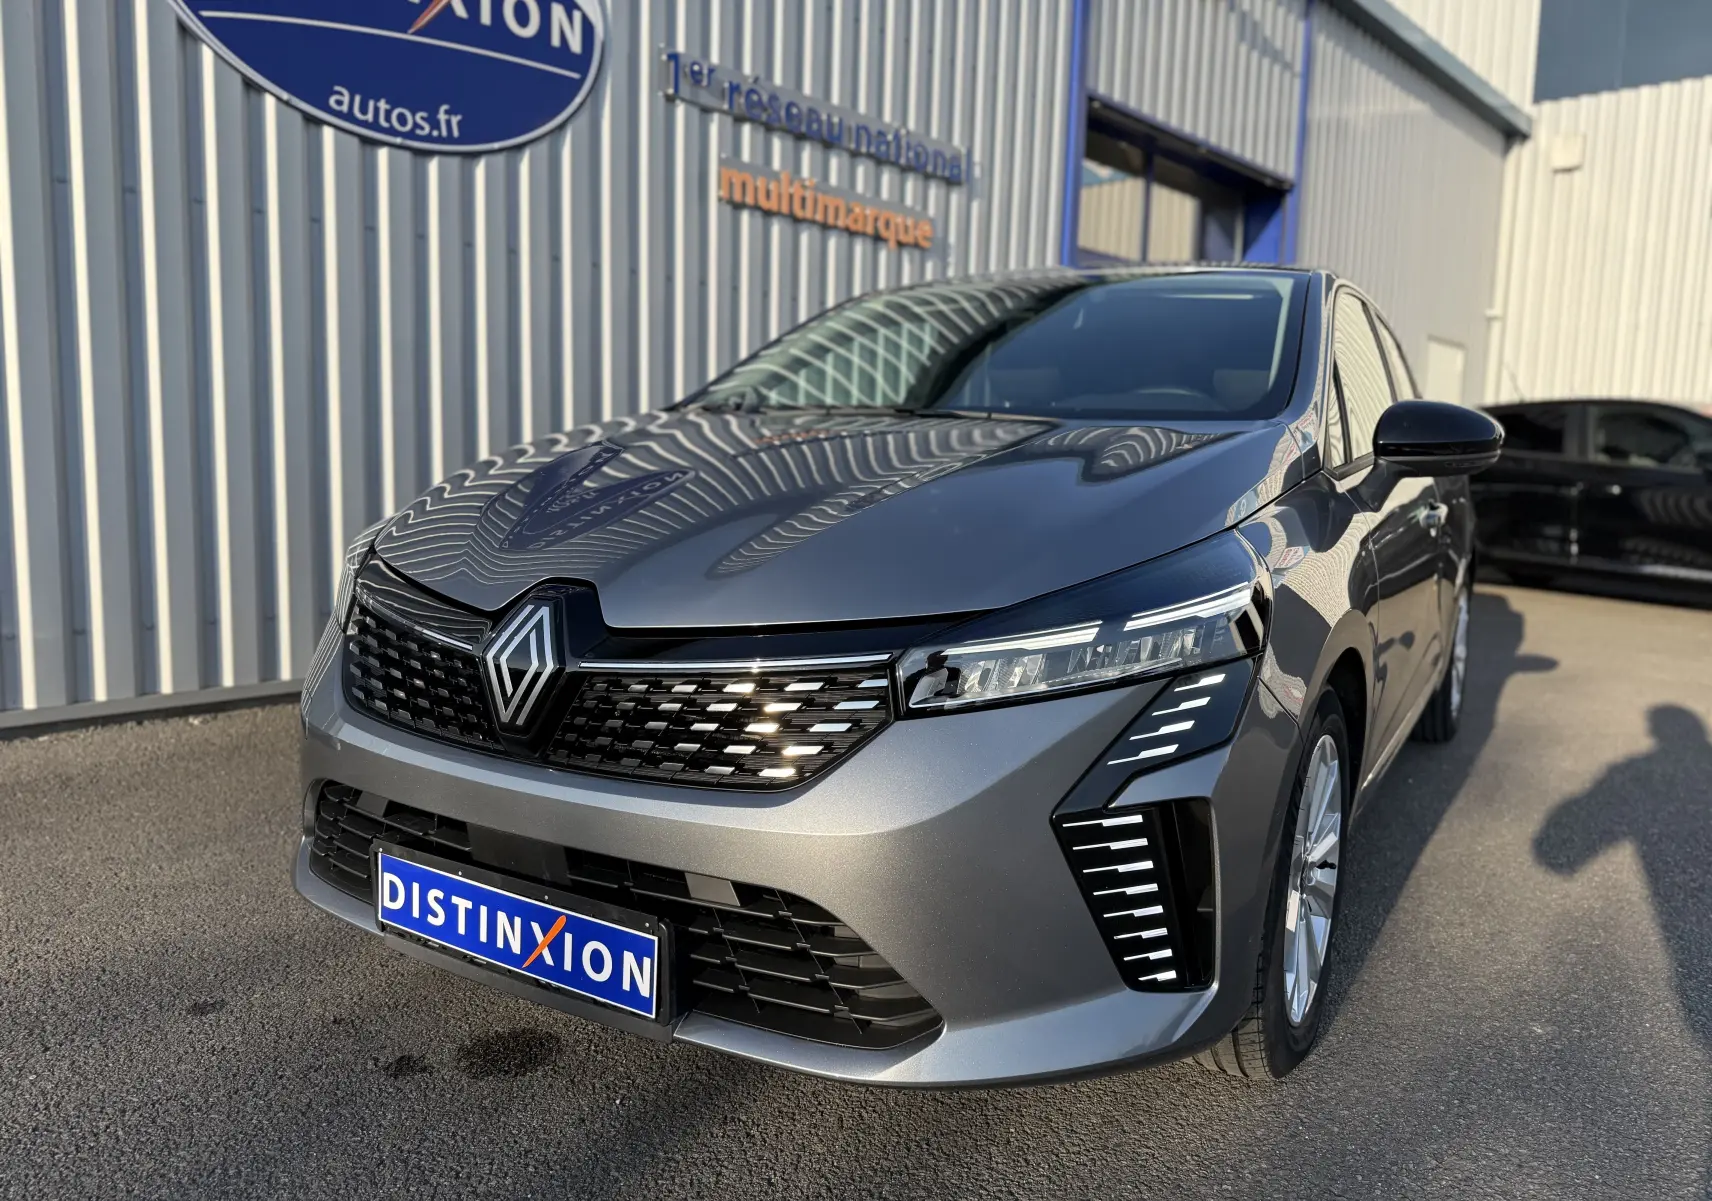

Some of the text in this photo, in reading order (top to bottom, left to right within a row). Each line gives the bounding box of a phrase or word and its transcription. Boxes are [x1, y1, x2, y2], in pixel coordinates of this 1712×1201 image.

[401, 0, 582, 55] XION
[328, 85, 463, 138] autos.fr
[728, 76, 843, 145] réseau
[855, 124, 972, 184] national
[720, 165, 934, 248] multimarque
[381, 871, 652, 999] DISTINXION
